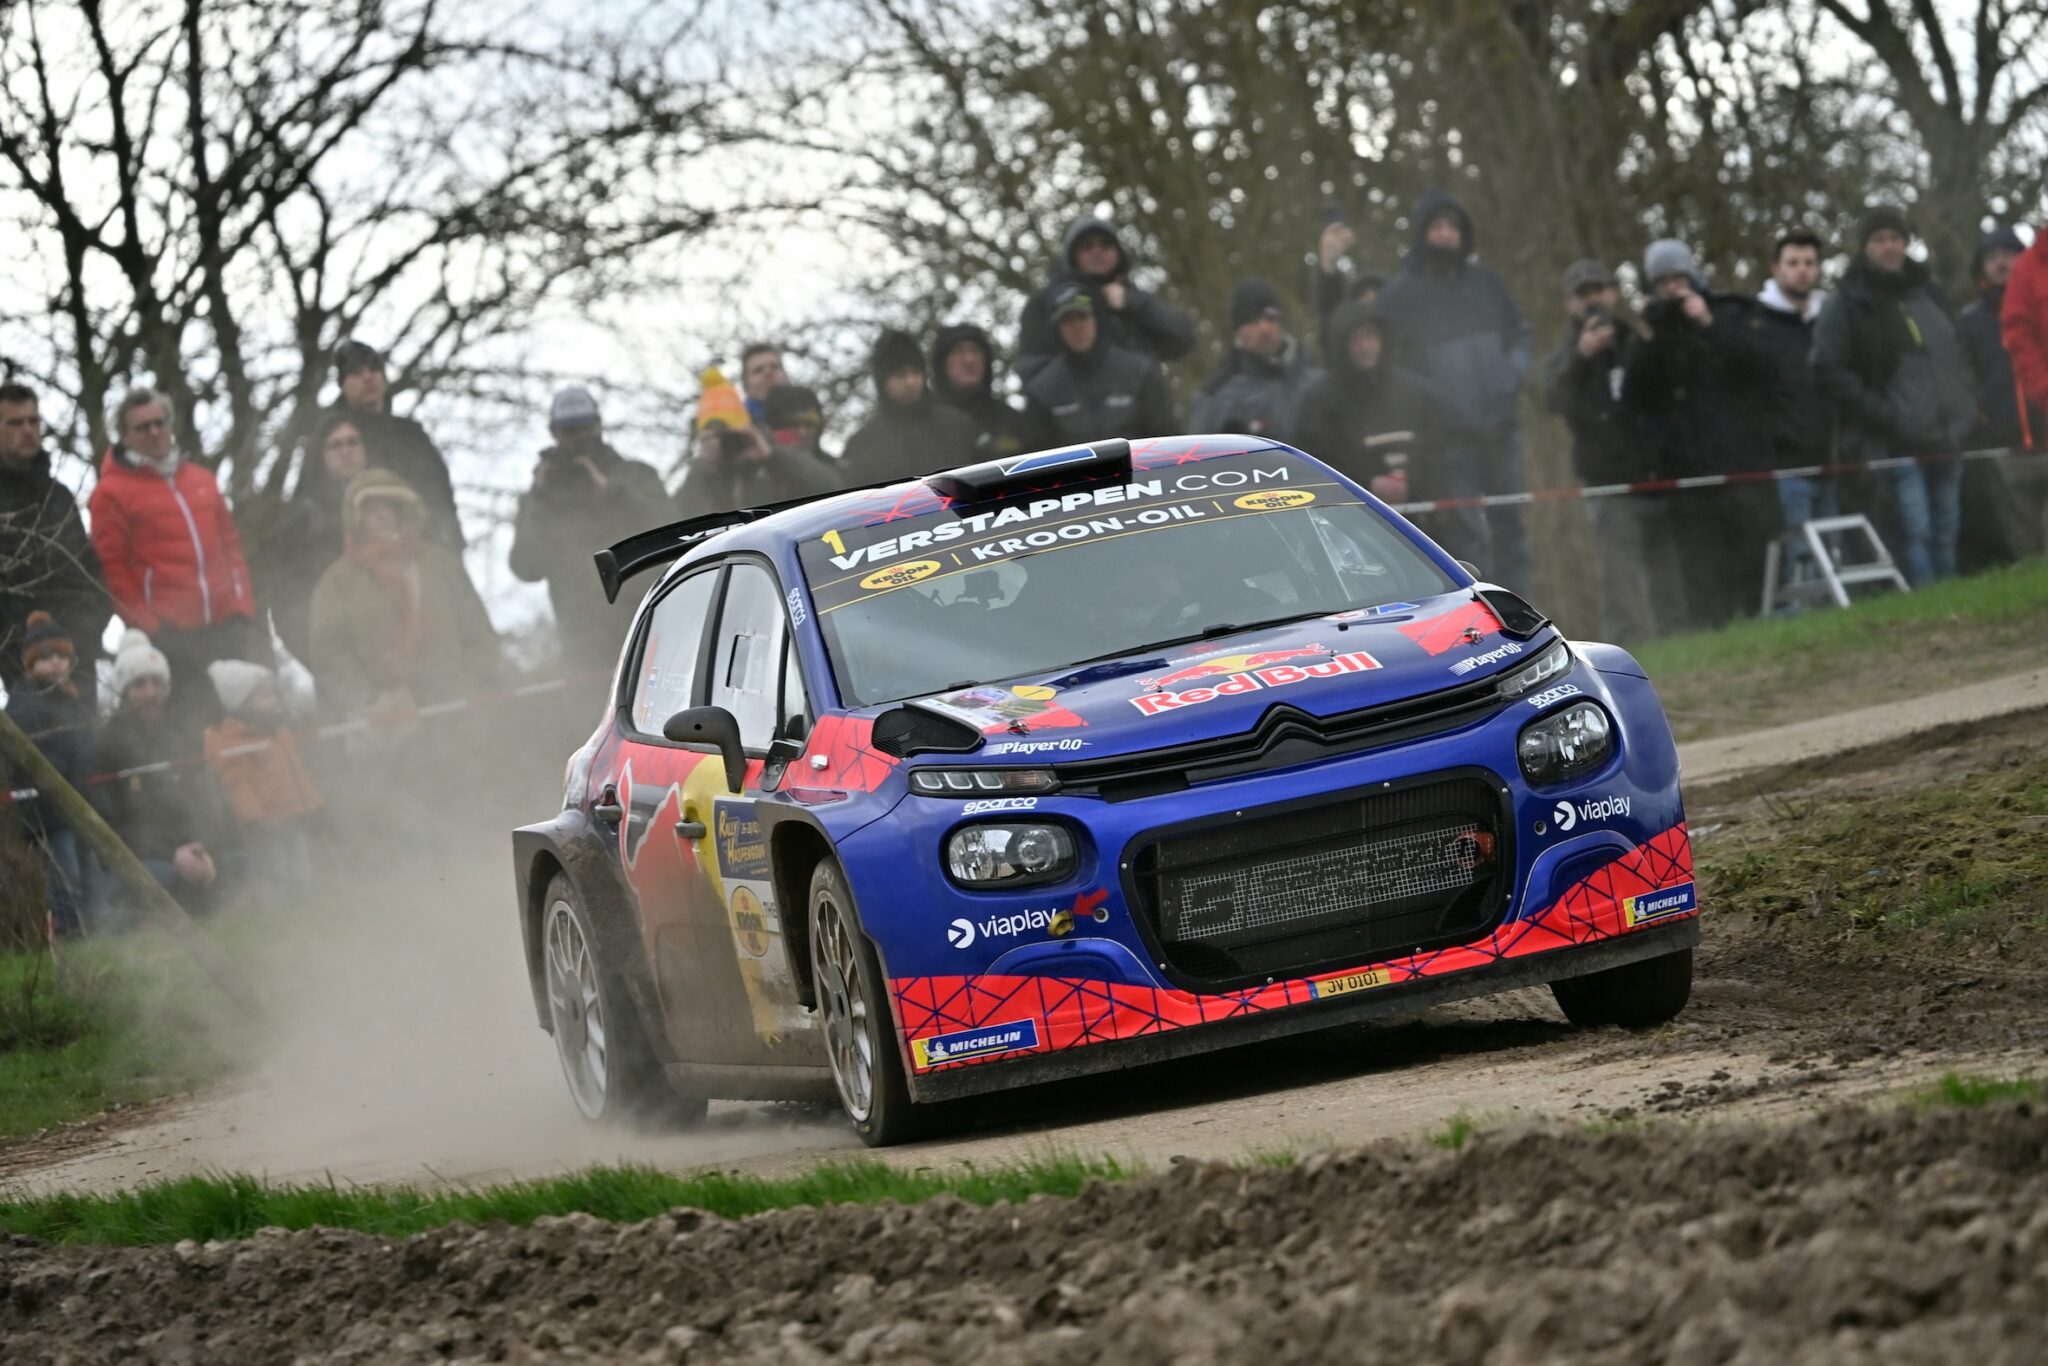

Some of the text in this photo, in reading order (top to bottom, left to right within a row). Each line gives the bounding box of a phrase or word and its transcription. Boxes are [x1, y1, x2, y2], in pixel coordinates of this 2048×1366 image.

[1245, 493, 1304, 506] KROON
[829, 467, 1289, 570] VERSTAPPEN.COM
[821, 529, 846, 554] 1
[970, 504, 1206, 560] KROON-OIL
[870, 564, 929, 585] KROON
[890, 574, 917, 585] OIL
[1466, 651, 1508, 669] Player
[1129, 651, 1384, 716] Red Bull
[1528, 684, 1580, 707] sparco
[1000, 741, 1059, 755] Player
[962, 797, 1038, 814] sparco
[1578, 796, 1631, 821] viaplay
[1647, 893, 1688, 912] MICHELIN
[1327, 972, 1380, 993] JV 0101
[950, 1030, 1021, 1053] MICHELIN
